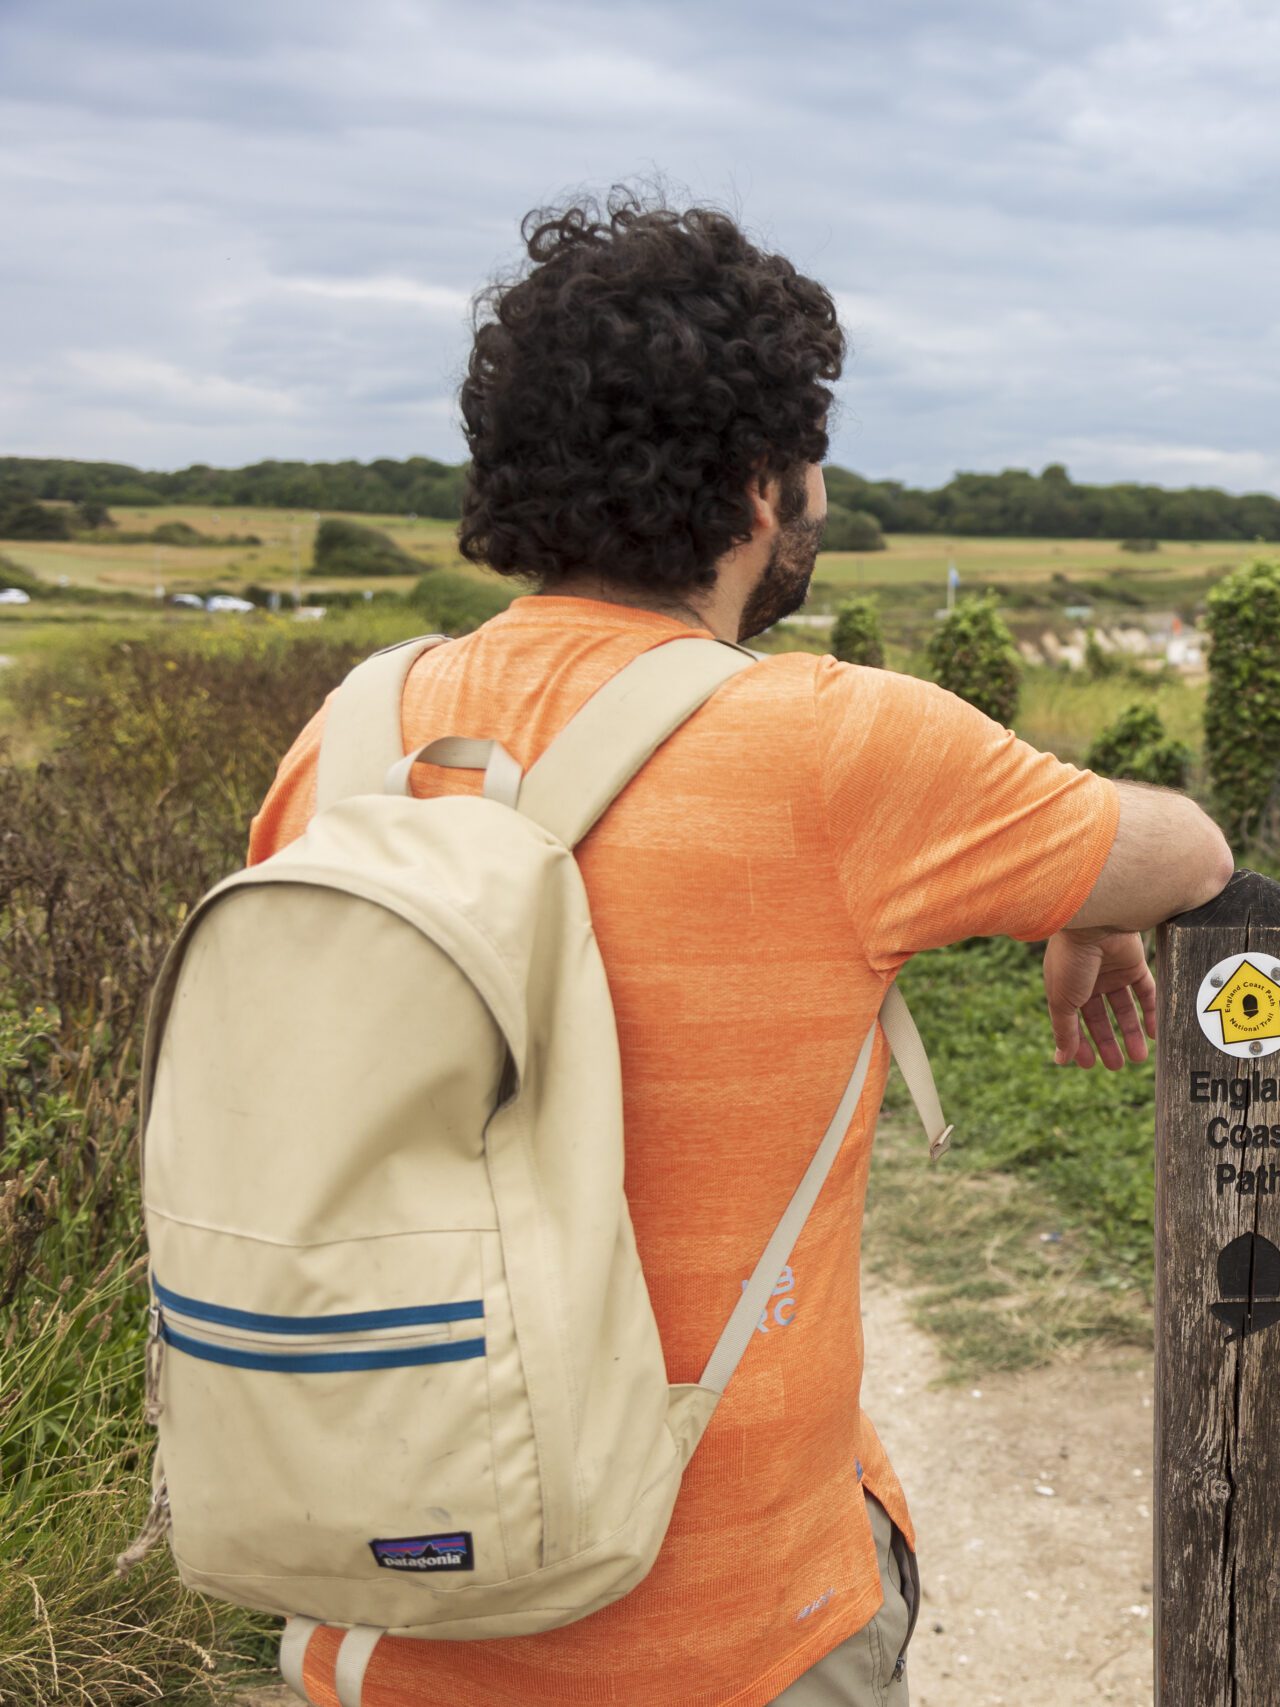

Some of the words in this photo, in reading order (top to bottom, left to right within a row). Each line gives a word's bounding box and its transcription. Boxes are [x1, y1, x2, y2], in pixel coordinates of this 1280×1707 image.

[1225, 985, 1241, 1013] England
[1243, 981, 1265, 991] Coast
[1265, 989, 1276, 1007] Path
[1229, 1017, 1260, 1032] National
[1260, 1013, 1274, 1028] Trail
[383, 1553, 462, 1568] patagonia
